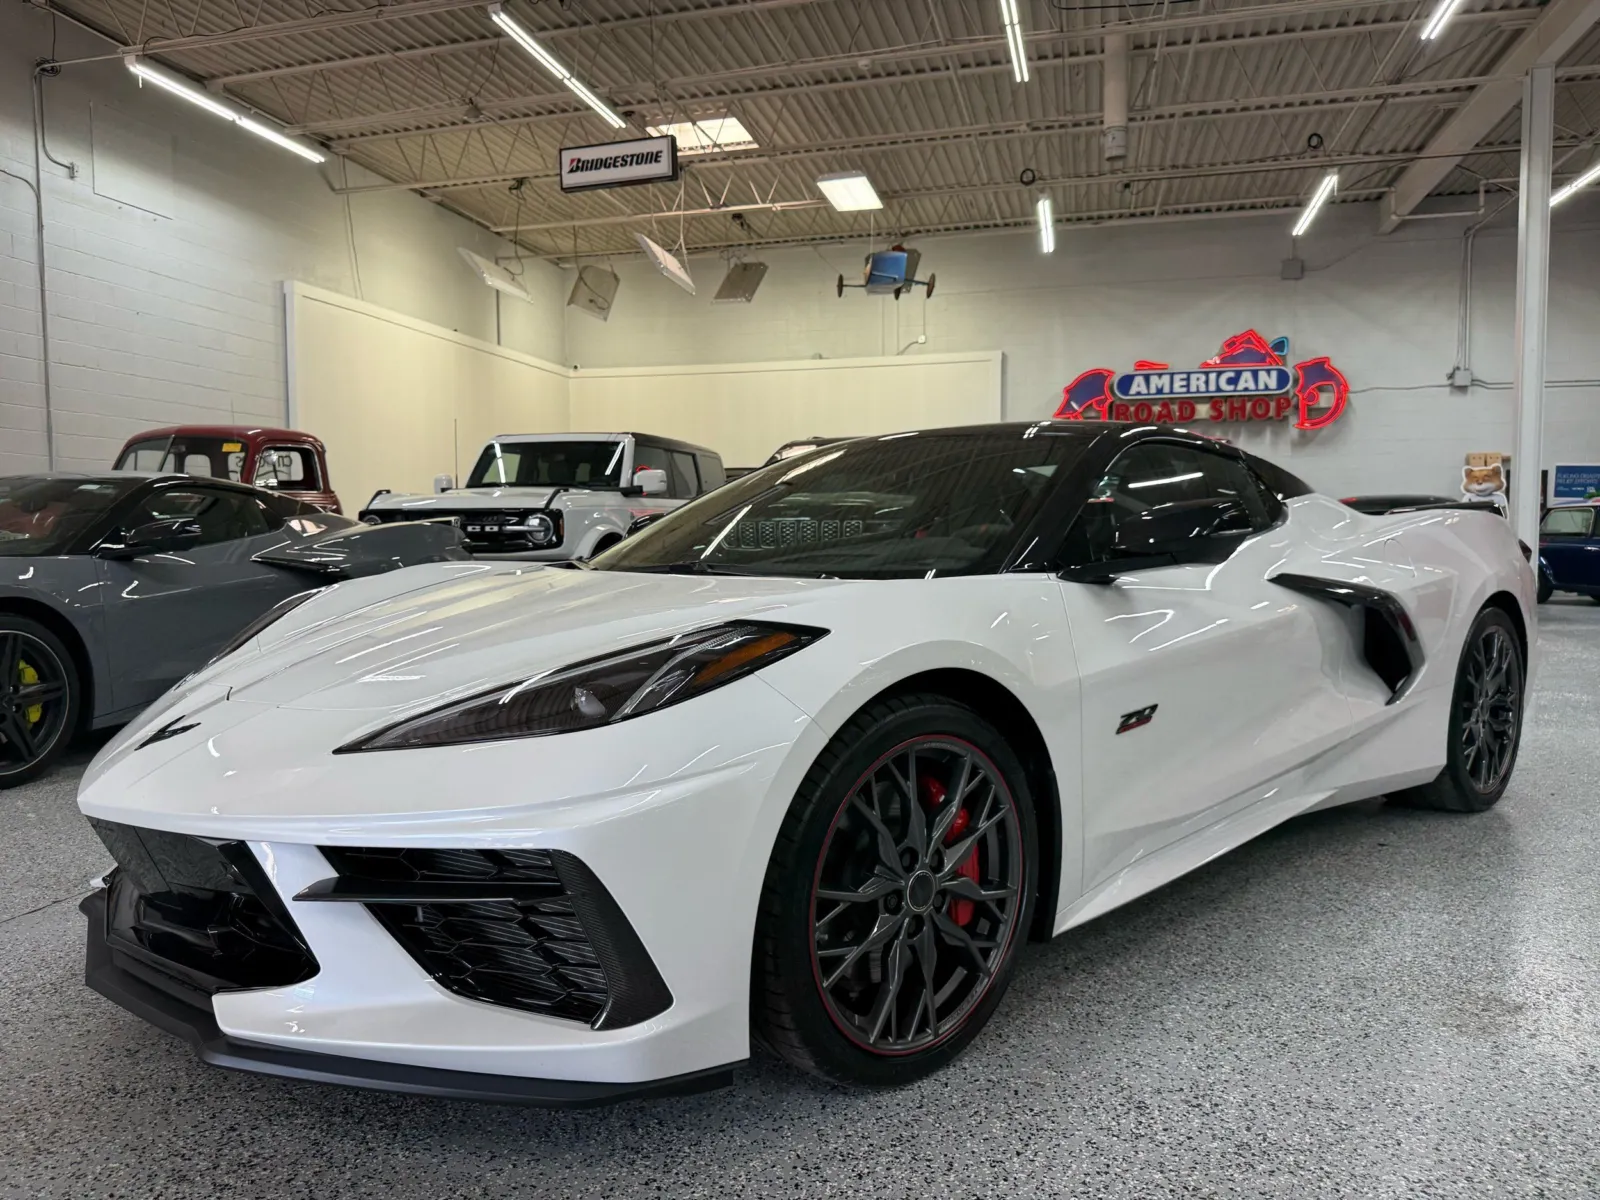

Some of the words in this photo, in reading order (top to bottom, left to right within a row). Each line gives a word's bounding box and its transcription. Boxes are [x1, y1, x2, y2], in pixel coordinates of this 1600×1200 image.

[567, 150, 663, 174] BRIDGESTONE
[1128, 369, 1279, 395] AMERICAN
[1113, 400, 1196, 423] ROAD
[1209, 397, 1292, 422] SHOP
